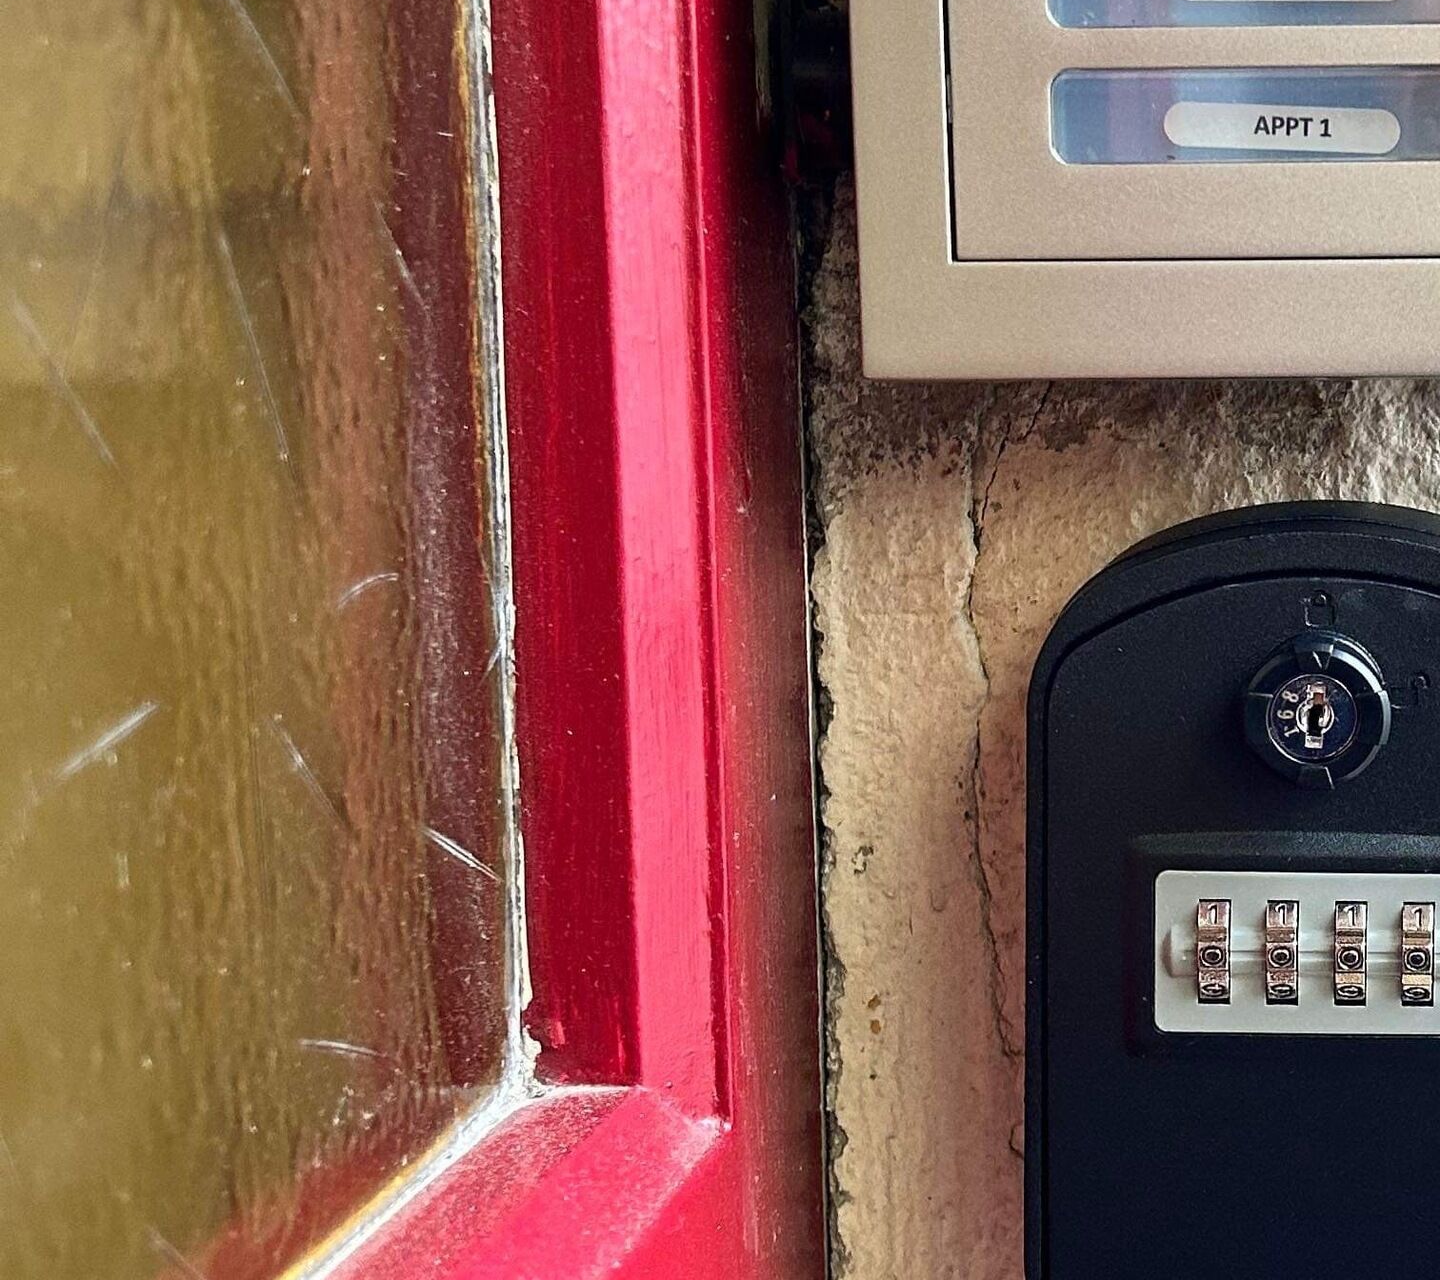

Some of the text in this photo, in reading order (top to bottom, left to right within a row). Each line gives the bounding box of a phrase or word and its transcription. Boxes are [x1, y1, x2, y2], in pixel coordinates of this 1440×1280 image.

[1253, 115, 1332, 138] APPT 1
[1200, 944, 1430, 971] 0 0 0 0
